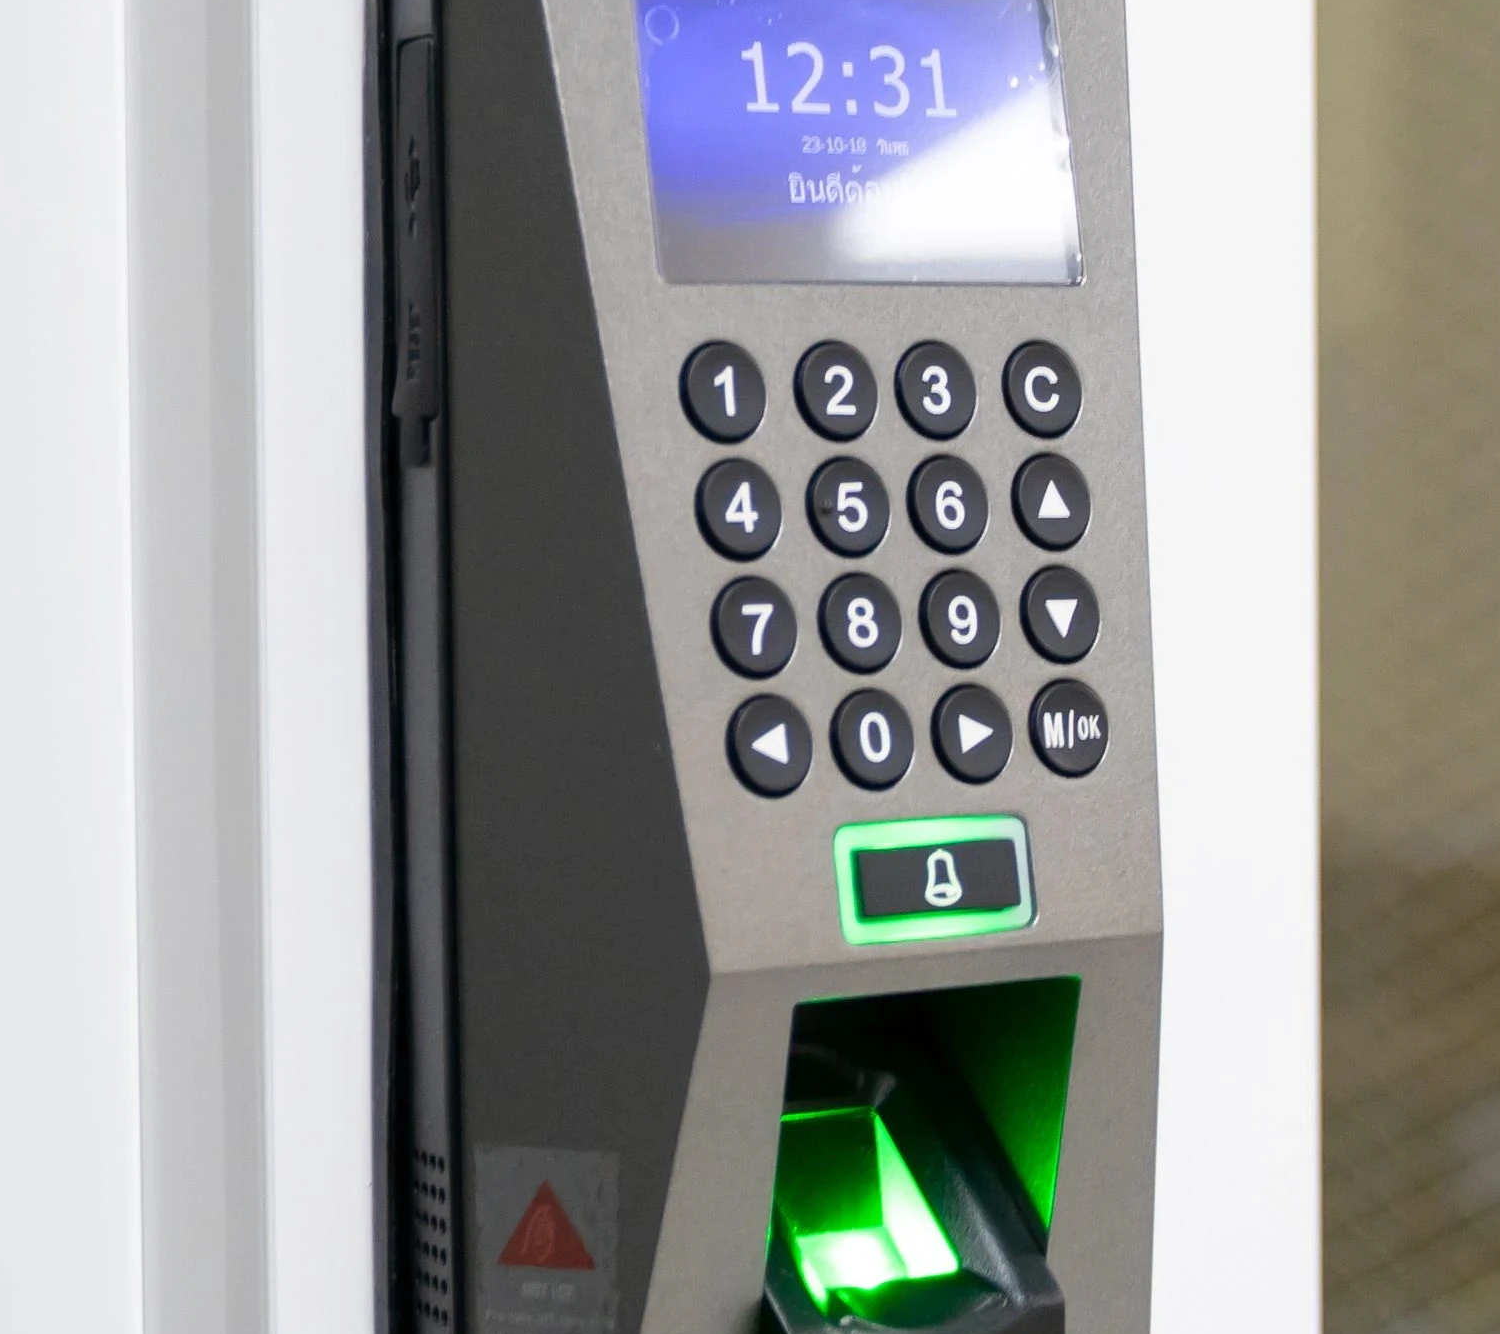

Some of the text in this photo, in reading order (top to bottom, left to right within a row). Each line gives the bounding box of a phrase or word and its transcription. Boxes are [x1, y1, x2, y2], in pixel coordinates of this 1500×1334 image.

[741, 41, 958, 120] 12:31
[714, 365, 1060, 416] 1 2 3 C
[725, 481, 965, 532] 4 5 6
[742, 596, 977, 655] 7 8 9
[860, 712, 891, 762] 0
